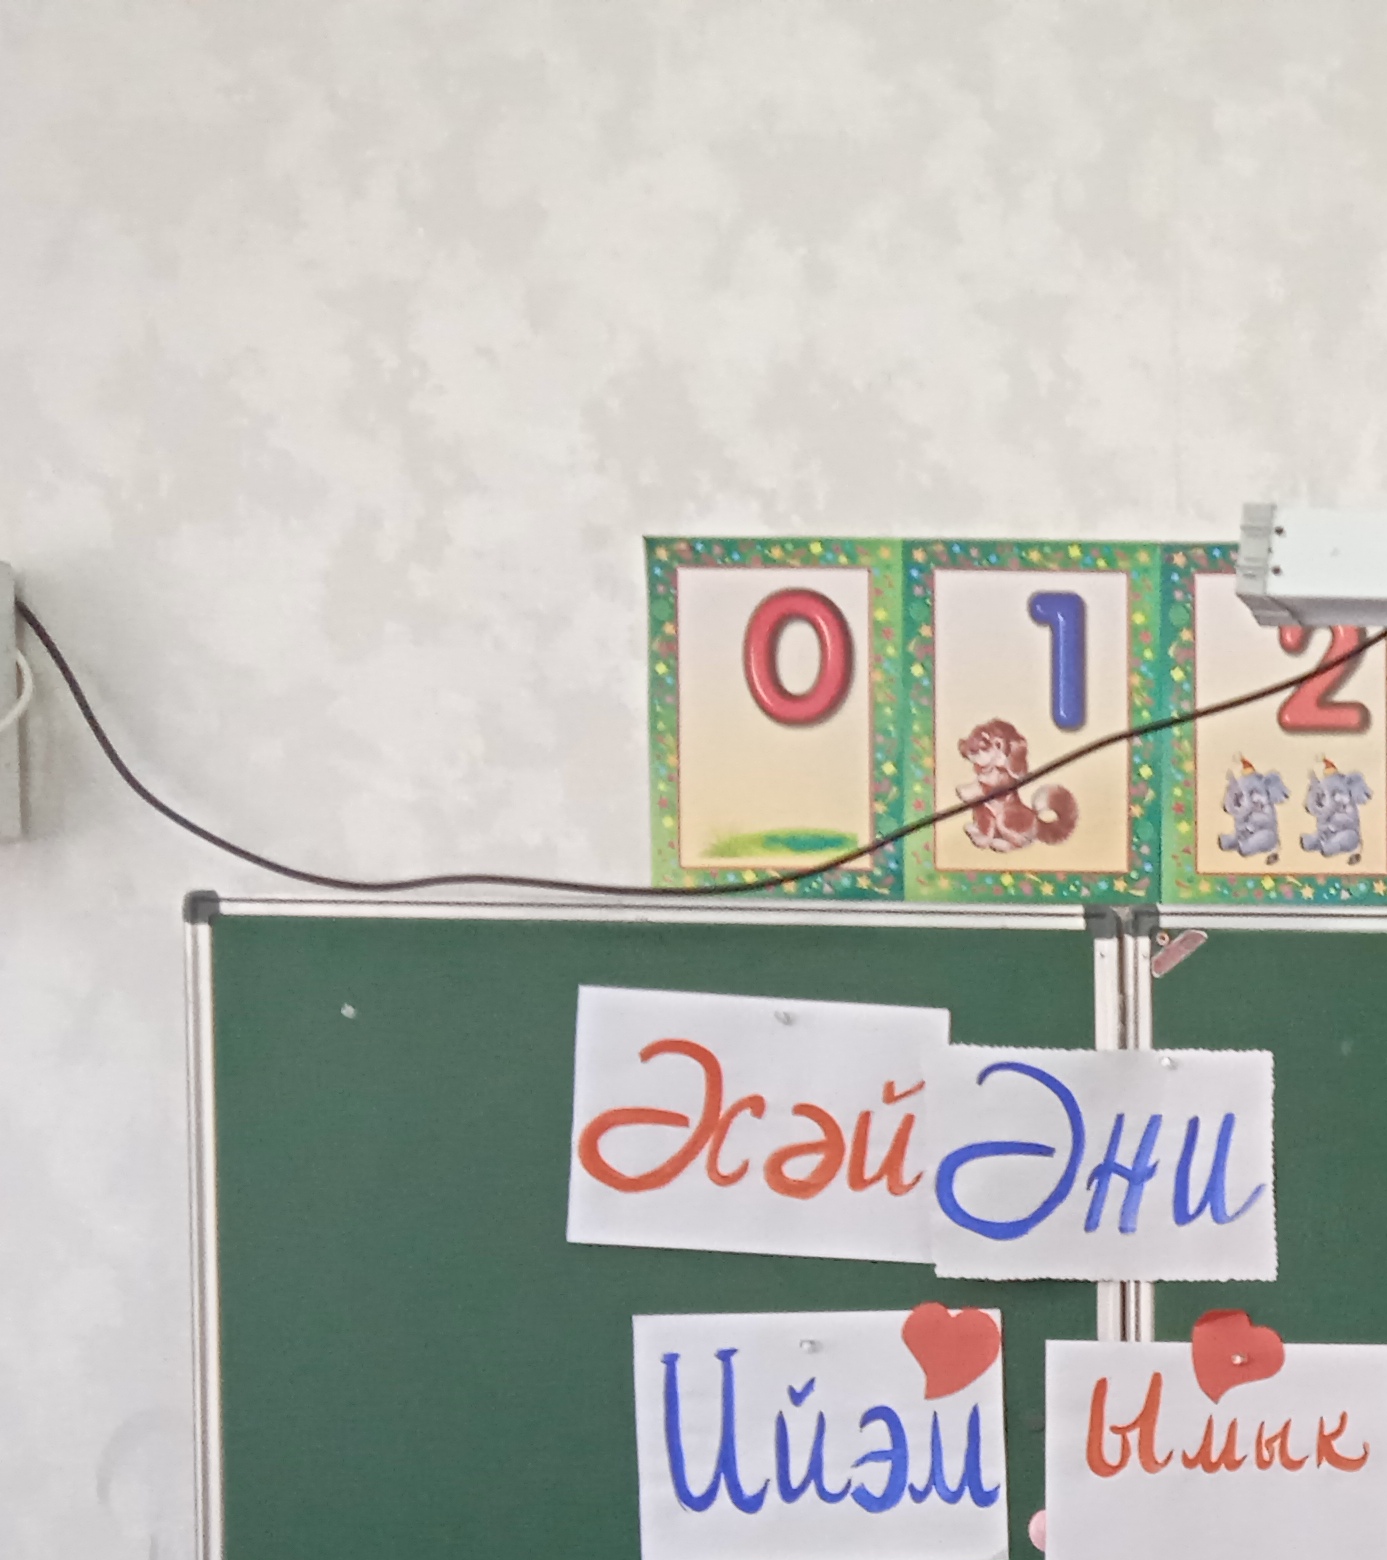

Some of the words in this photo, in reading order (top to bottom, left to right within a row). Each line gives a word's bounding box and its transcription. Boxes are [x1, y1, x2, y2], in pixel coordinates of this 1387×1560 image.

[743, 587, 855, 728] 0
[1027, 590, 1087, 731] 1
[1276, 623, 1373, 734] 2
